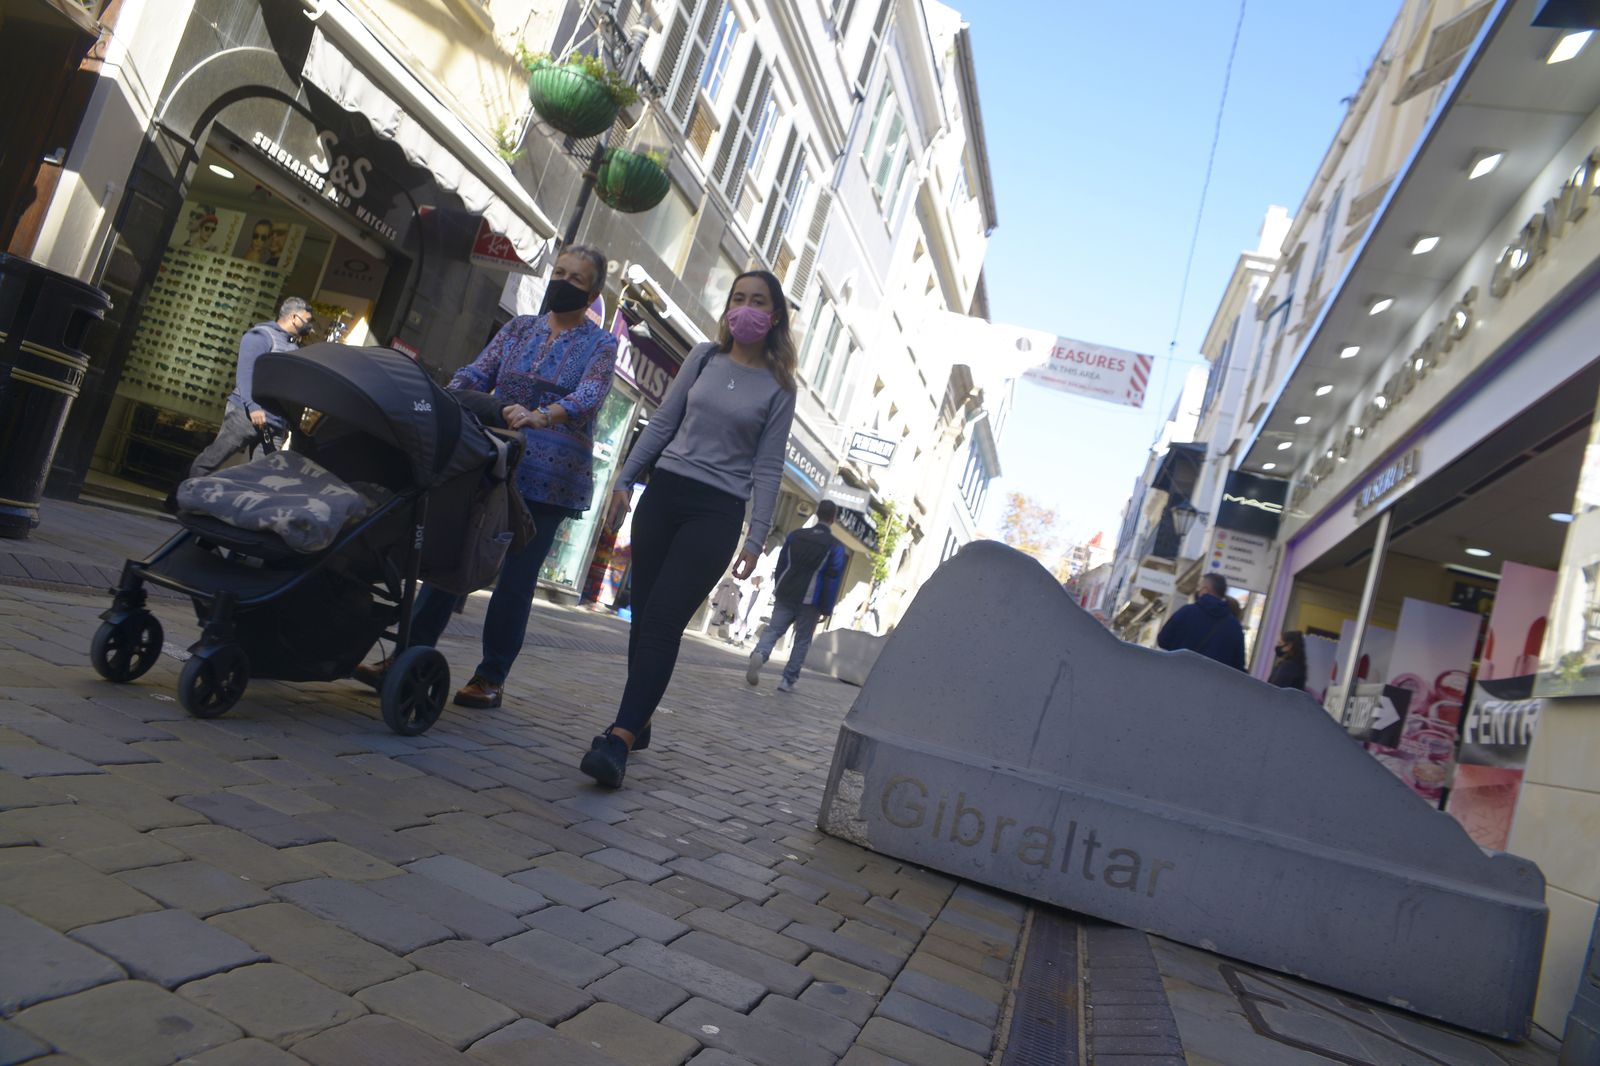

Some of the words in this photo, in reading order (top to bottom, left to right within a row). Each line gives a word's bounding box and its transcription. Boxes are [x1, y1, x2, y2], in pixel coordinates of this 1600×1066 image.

[252, 131, 327, 191] SUNGLASSES
[355, 205, 399, 241] WATCHES
[309, 130, 373, 199] S&S
[880, 775, 1176, 898] Gibraltar
